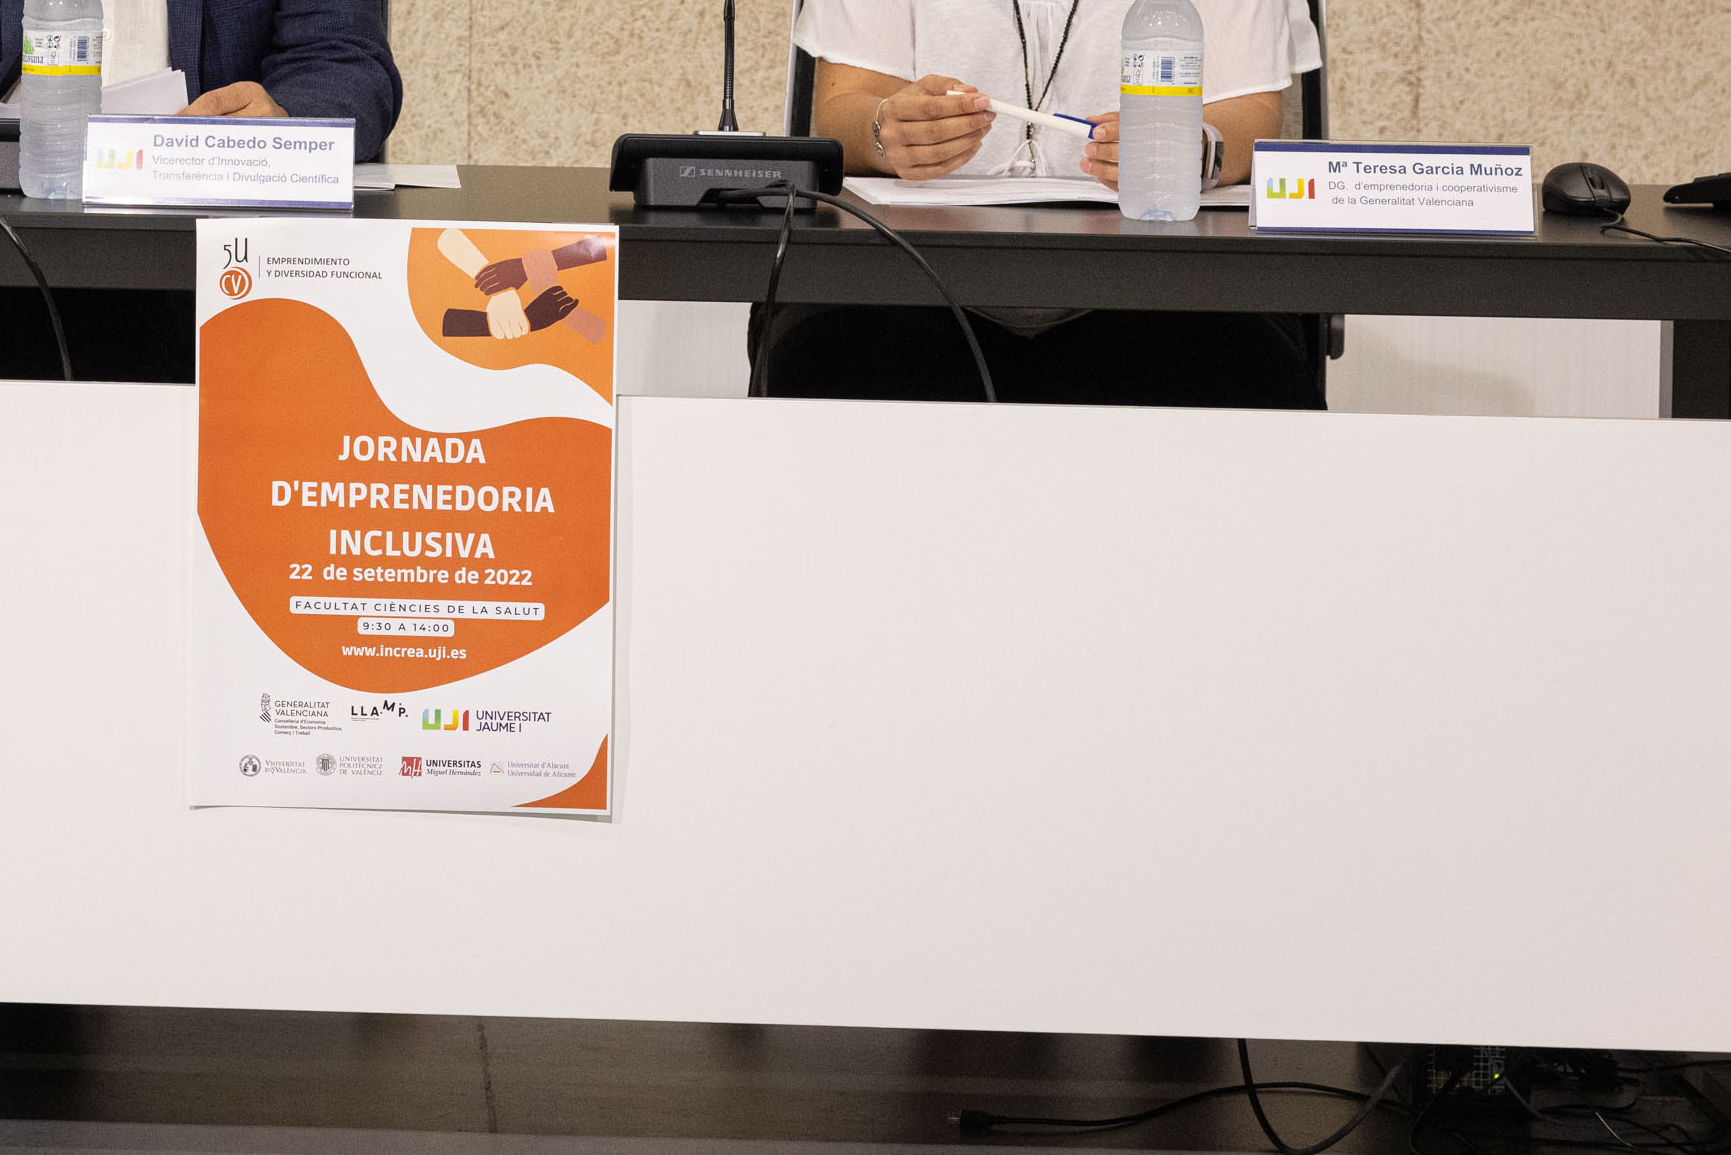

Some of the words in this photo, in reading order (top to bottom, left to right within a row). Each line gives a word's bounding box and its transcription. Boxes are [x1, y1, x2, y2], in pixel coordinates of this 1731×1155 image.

[153, 134, 200, 148] David
[204, 135, 267, 150] Cabedo
[272, 137, 335, 153] Semper
[152, 155, 205, 166] Vicerector
[208, 155, 271, 168] d'Innovació,
[699, 168, 782, 179] SENNHEISER
[1353, 161, 1407, 175] Teresa
[1412, 162, 1464, 175] Garcia
[1470, 163, 1523, 177] Muñoz
[153, 171, 224, 181] Transferència
[232, 172, 287, 184] Divulgació
[290, 173, 340, 184] Científica
[1328, 181, 1348, 191] DG.
[1355, 182, 1432, 193] d'emprenedoria
[1442, 183, 1518, 195] cooperativisme
[1332, 196, 1345, 205] de
[1348, 196, 1356, 205] la
[1360, 196, 1416, 205] Generalitat
[1418, 197, 1474, 207] Valenciana
[267, 257, 350, 266] EMPRENDIMIENTO
[274, 270, 328, 278] DIVERSIDAD
[331, 271, 383, 279] FUNCIONAL
[338, 435, 486, 464] JORNADA
[272, 480, 555, 513] D'EMPRENEDORIA
[330, 529, 495, 559] INCLUSIVA
[289, 564, 313, 580] 22
[323, 563, 347, 581] de
[352, 564, 449, 583] setembre
[454, 567, 479, 584] de
[484, 569, 532, 586] 2022
[295, 601, 368, 612] FACULTAT
[374, 600, 441, 614] CIÈNCIES
[447, 604, 467, 614] DE
[472, 605, 489, 615] LA
[495, 605, 540, 616] SALUT
[363, 622, 392, 632] 9:30
[398, 622, 407, 632] A
[413, 623, 450, 633] 14:00
[342, 644, 467, 661] www.increa.uji.es
[275, 709, 329, 717] VALENCIANA
[476, 710, 551, 722] UNIVERSITAT
[422, 709, 469, 731] UJI
[476, 722, 515, 732] JAUME
[519, 723, 521, 732] I
[426, 760, 481, 768] UNIVERSITAS
[427, 768, 448, 777] Miguel
